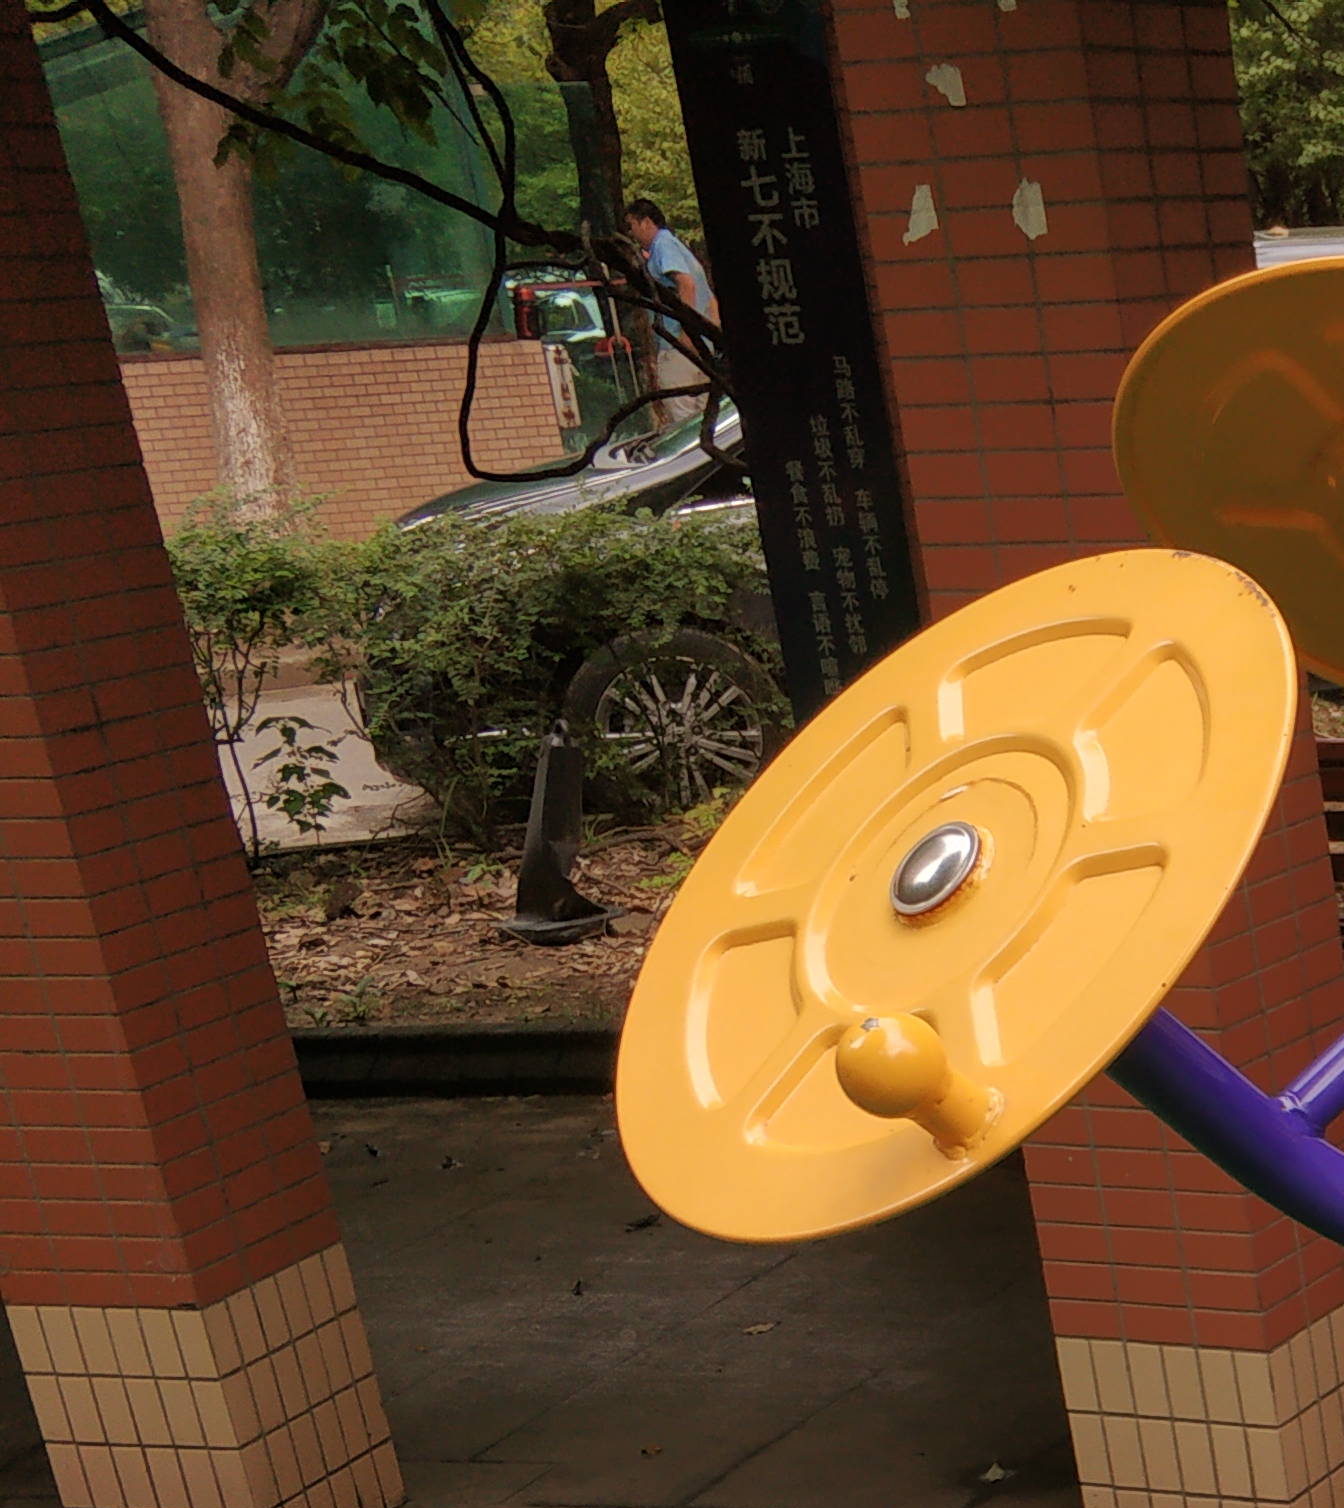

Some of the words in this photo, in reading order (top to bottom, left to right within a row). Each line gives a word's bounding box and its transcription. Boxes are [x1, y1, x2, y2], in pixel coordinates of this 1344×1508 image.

[736, 127, 806, 346] 新七不规范
[781, 126, 821, 230] 上海市
[785, 459, 821, 572] 餐食不浪费
[809, 413, 846, 527] 垃圾不乱扔
[832, 545, 869, 656] 宠物不扰邻
[832, 355, 866, 470] 马路不乱穿
[854, 488, 890, 600] 车辆不乱停
